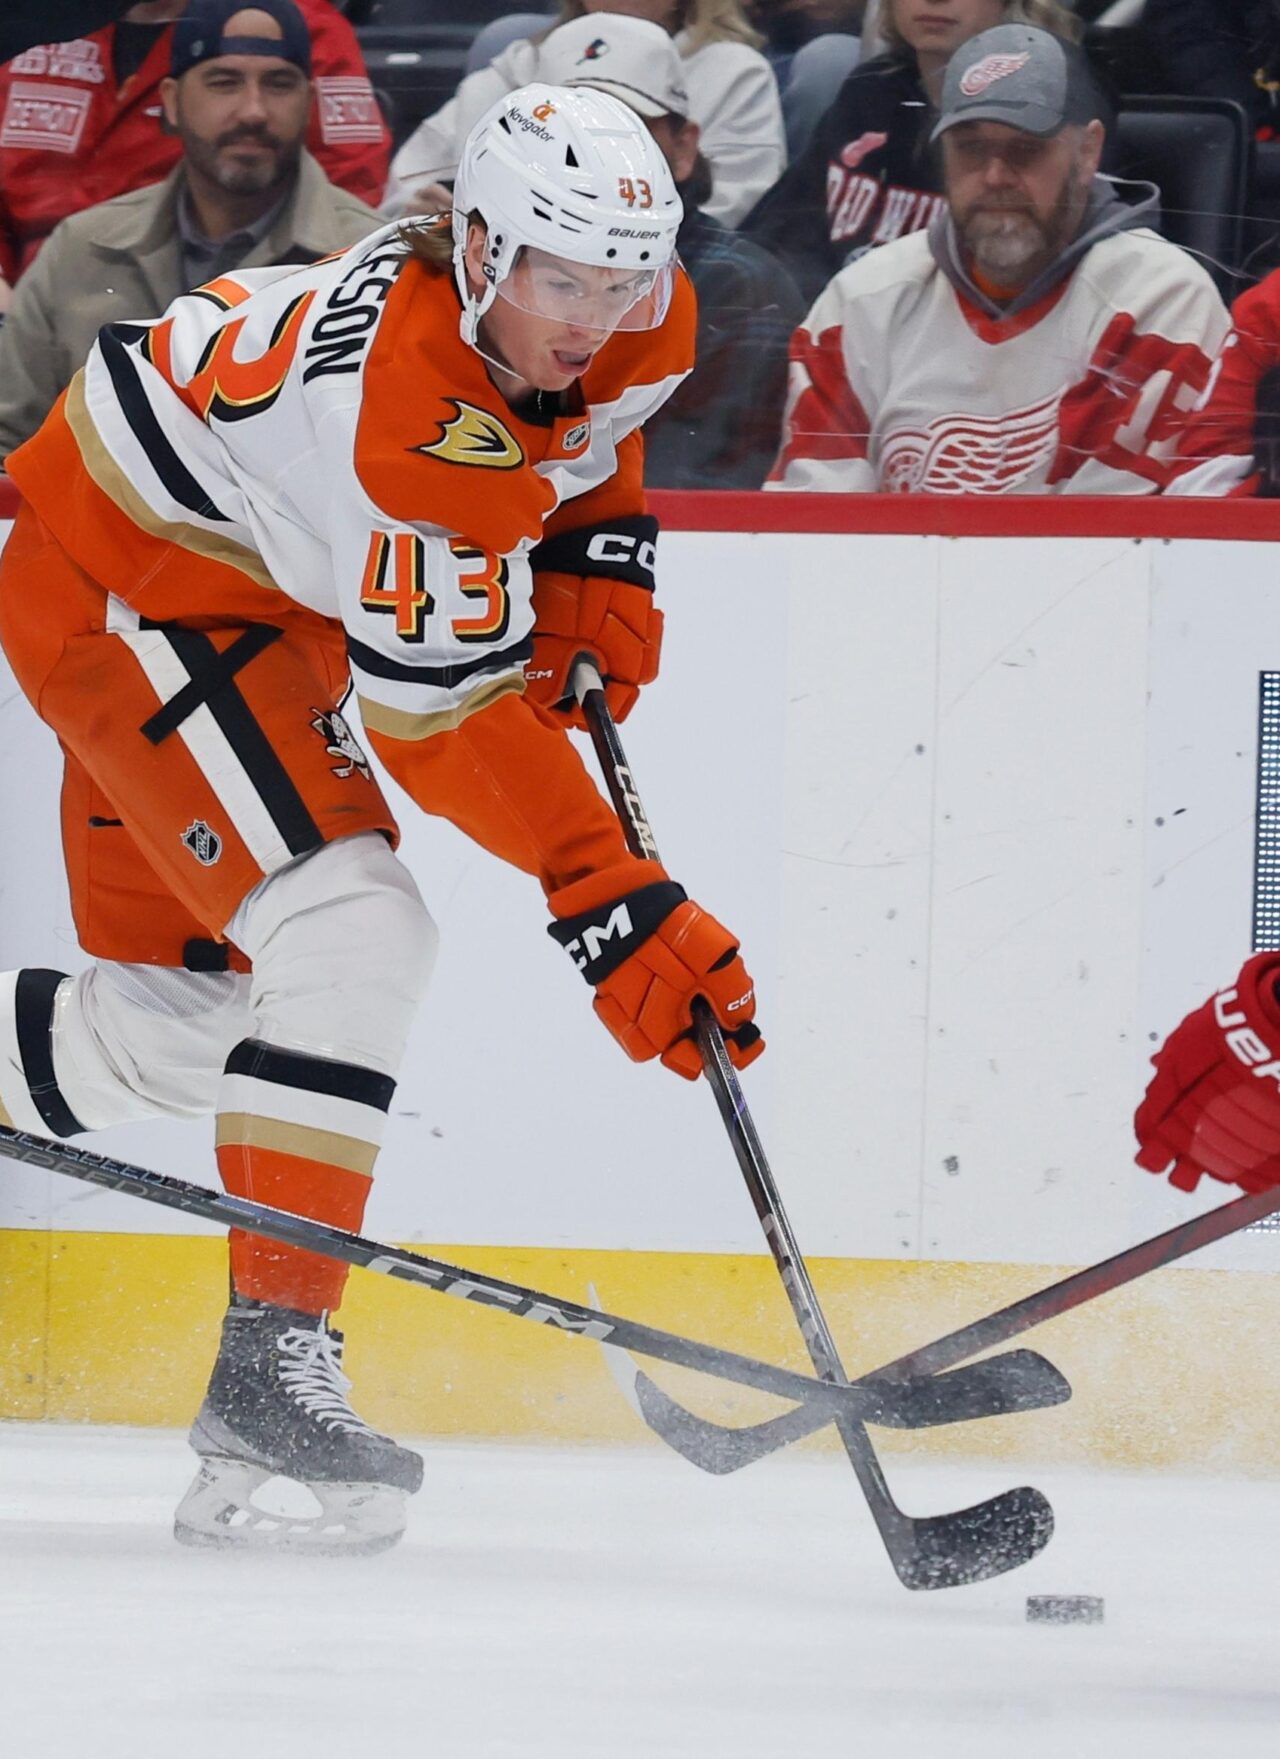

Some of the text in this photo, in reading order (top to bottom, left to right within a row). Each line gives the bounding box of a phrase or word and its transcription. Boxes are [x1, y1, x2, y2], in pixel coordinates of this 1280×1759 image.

[507, 107, 556, 142] Navigator
[618, 178, 653, 209] 43
[607, 227, 661, 240] BAUER
[360, 529, 510, 644] 43
[614, 764, 658, 853] CCM
[366, 1254, 616, 1342] CCM
